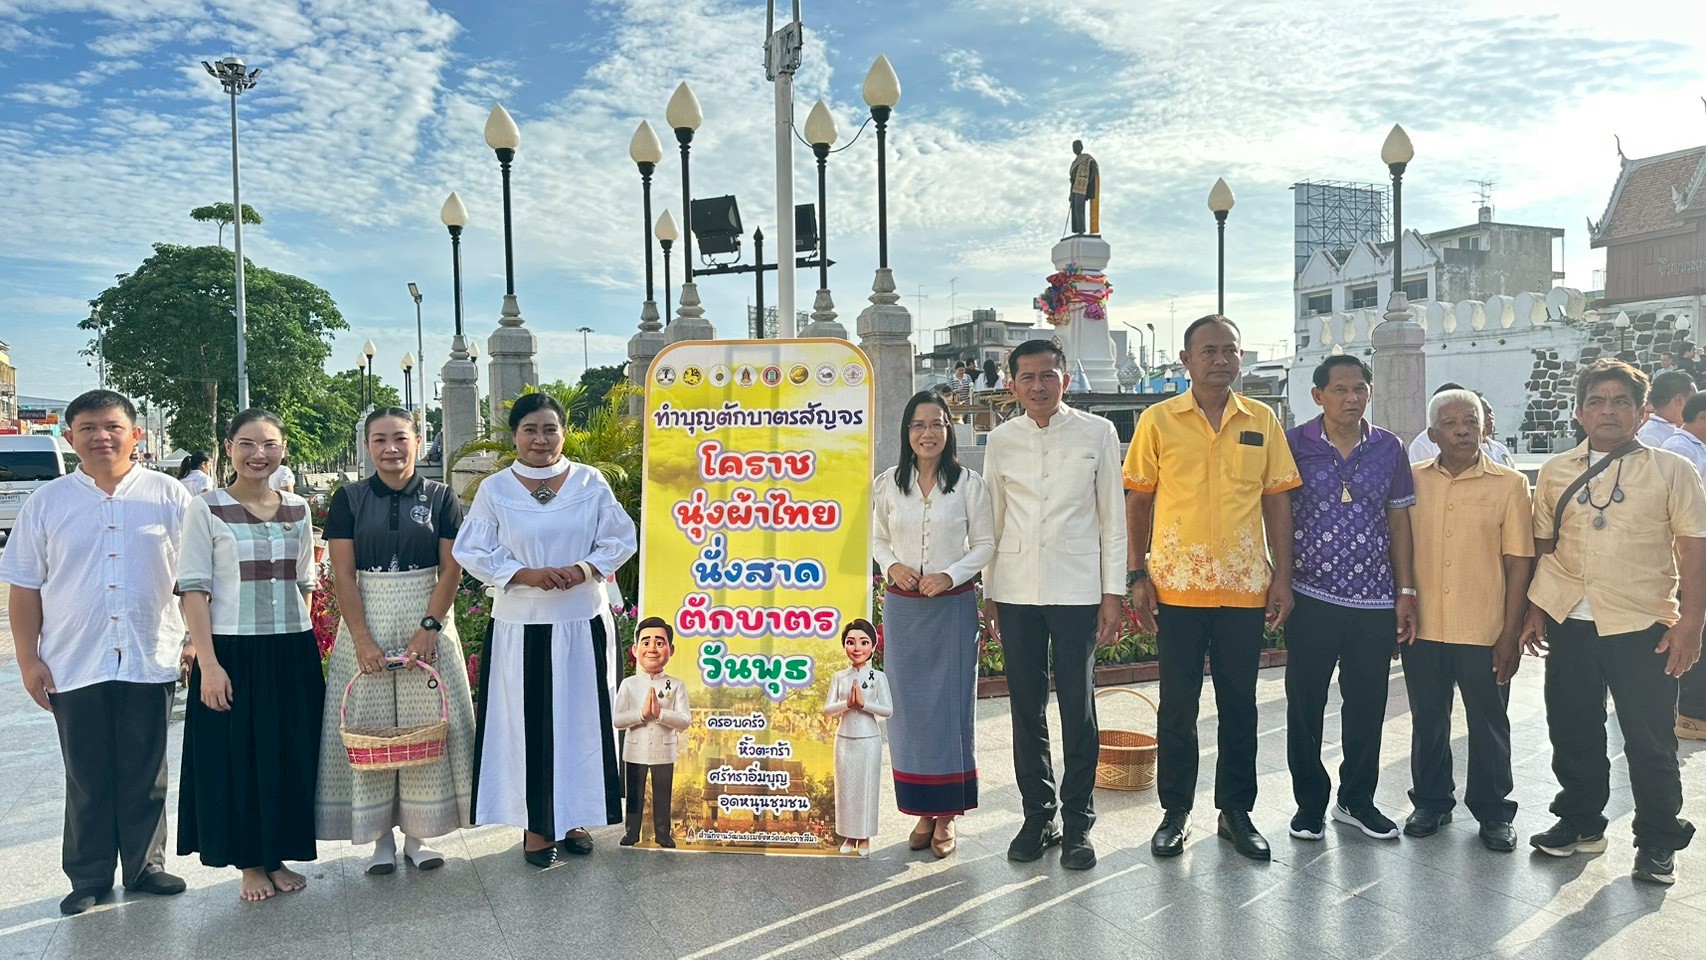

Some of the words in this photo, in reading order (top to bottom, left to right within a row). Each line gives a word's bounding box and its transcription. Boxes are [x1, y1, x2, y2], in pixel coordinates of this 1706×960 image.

[653, 402, 863, 435] ทำบุญตักบาตรสัญจร
[702, 445, 811, 477] โคราช
[676, 492, 836, 539] นุ่งผ้าไทย
[695, 536, 821, 584] นั่งสาด
[679, 595, 836, 632] ตักบาตร
[702, 643, 809, 695] วันพุธ
[707, 714, 766, 729] ครอบครัว
[738, 736, 791, 757] หิ้วตะกร้า
[709, 763, 787, 790] ศรัทธาอิ่มบุญ
[720, 796, 809, 814] อุดหนุนชุมชน
